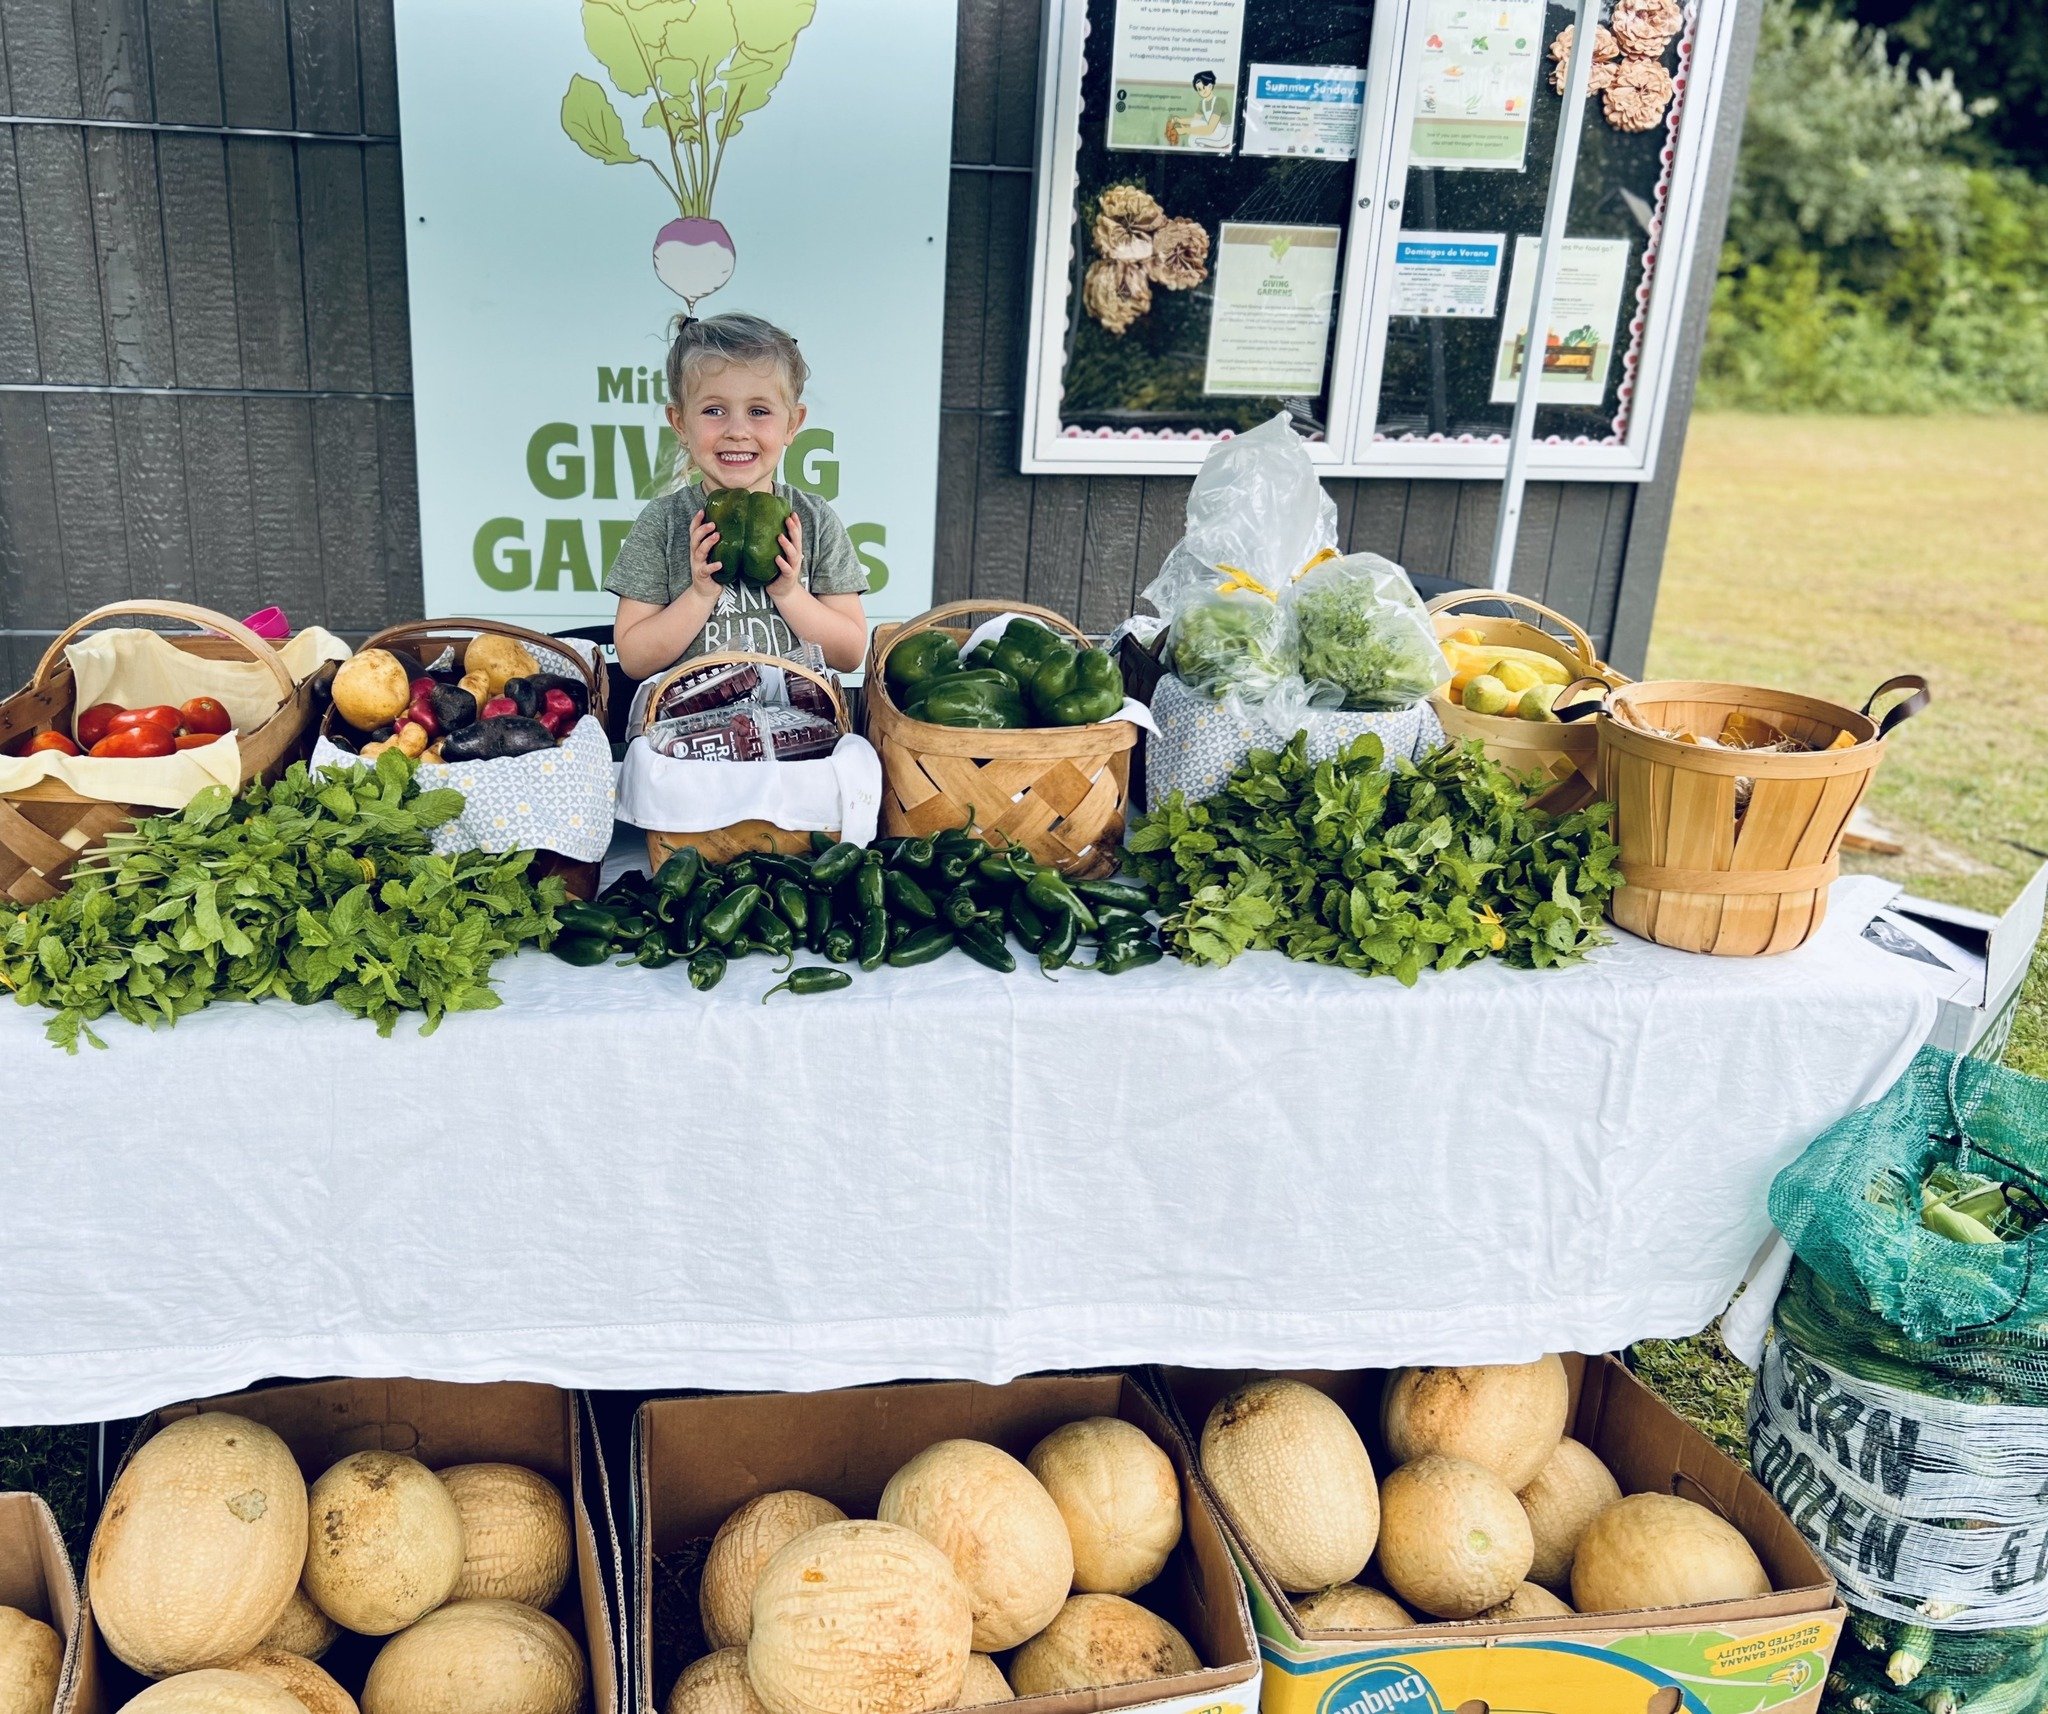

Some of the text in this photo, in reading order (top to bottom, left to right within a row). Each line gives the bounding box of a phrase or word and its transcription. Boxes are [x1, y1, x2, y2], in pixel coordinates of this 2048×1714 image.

[1213, 0, 1235, 8] Sunday
[1157, 25, 1191, 33] information
[1264, 80, 1311, 93] Summer
[1313, 82, 1359, 97] Sundays
[1404, 246, 1489, 259] Domingos de Verano
[1262, 279, 1289, 288] GIVING
[1257, 288, 1293, 297] GARDENS
[526, 421, 840, 501] GIVG
[704, 614, 792, 660] BUDD
[1718, 1625, 1821, 1660] SELECTED QUALITY
[1720, 1636, 1817, 1668] ORGANIC BANANA
[1334, 1674, 1427, 1714] Chiqu
